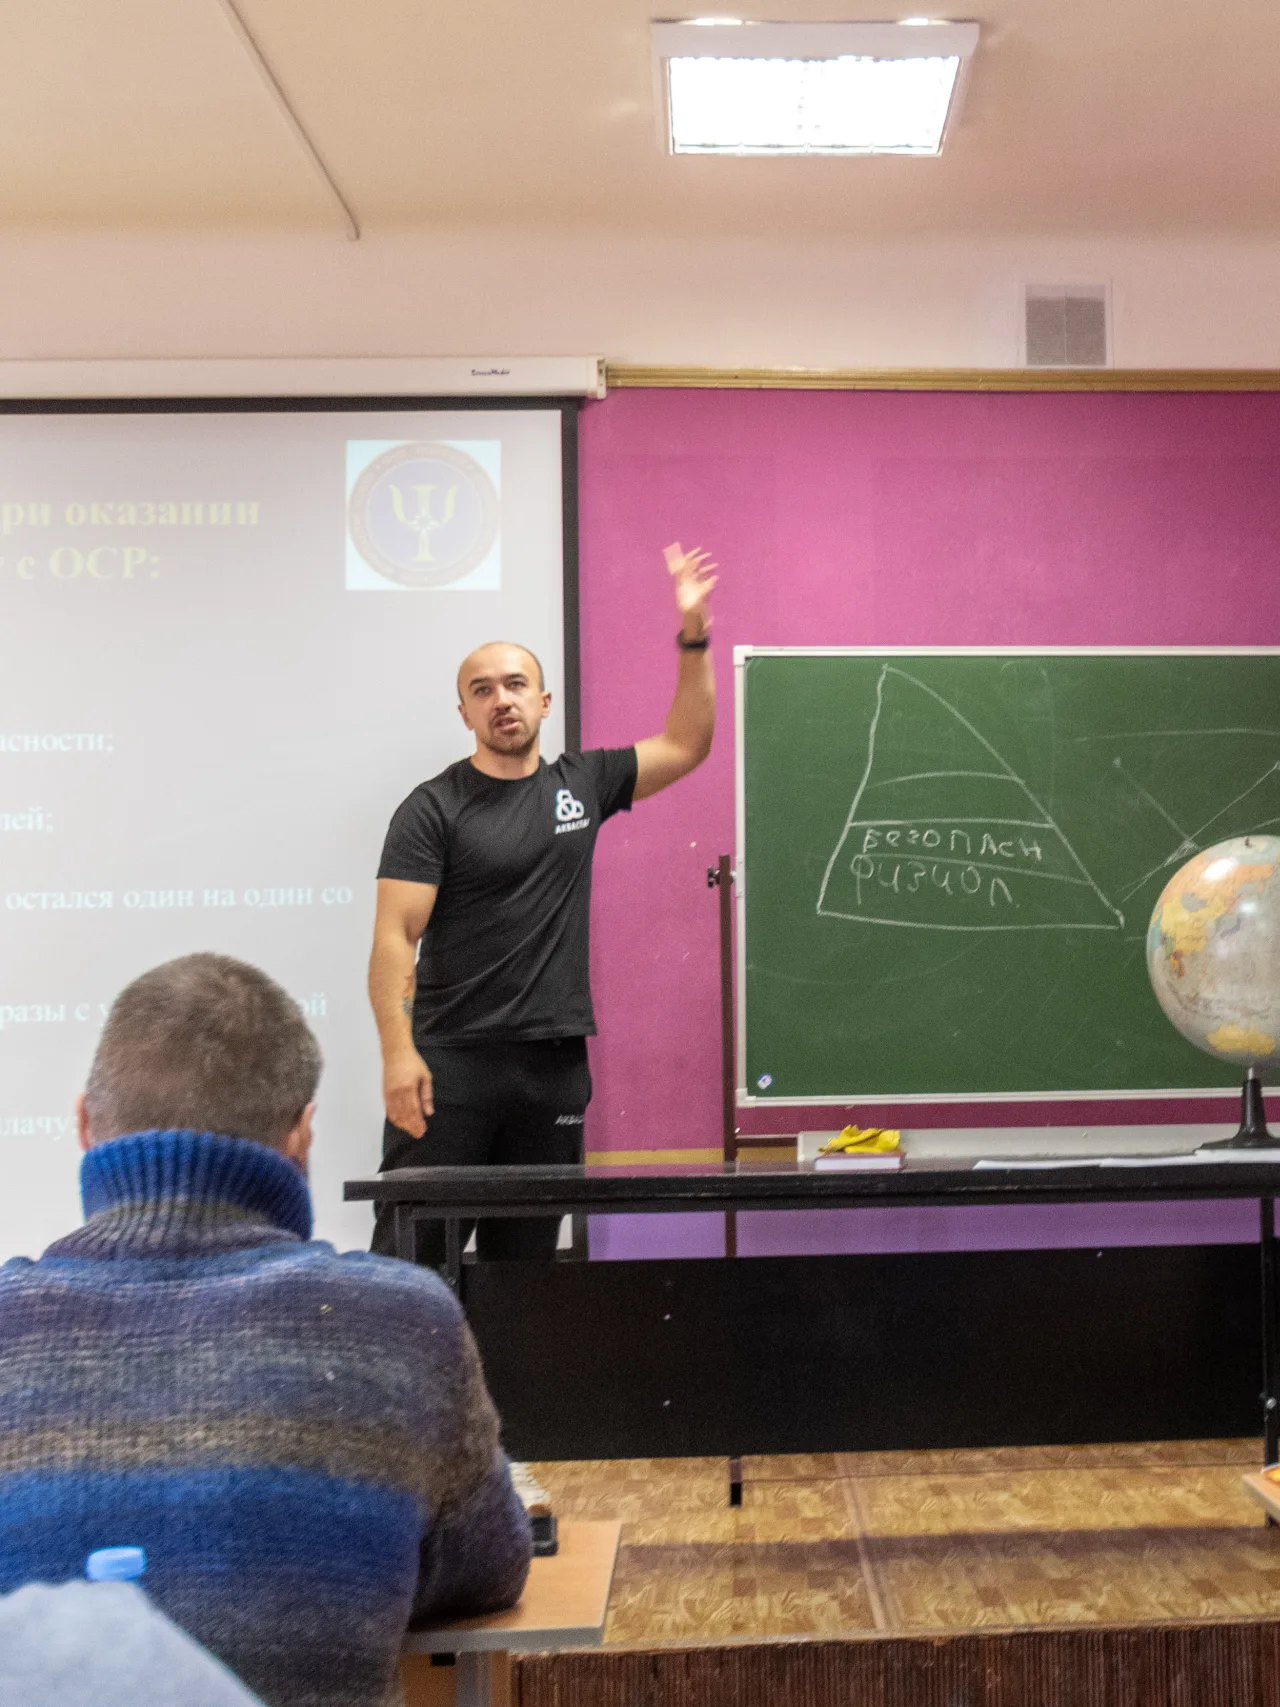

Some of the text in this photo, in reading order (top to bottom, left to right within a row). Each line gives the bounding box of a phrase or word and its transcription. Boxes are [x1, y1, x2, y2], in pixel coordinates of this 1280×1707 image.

[0, 501, 260, 536] ри оказании
[6, 886, 354, 910] остался один на один со
